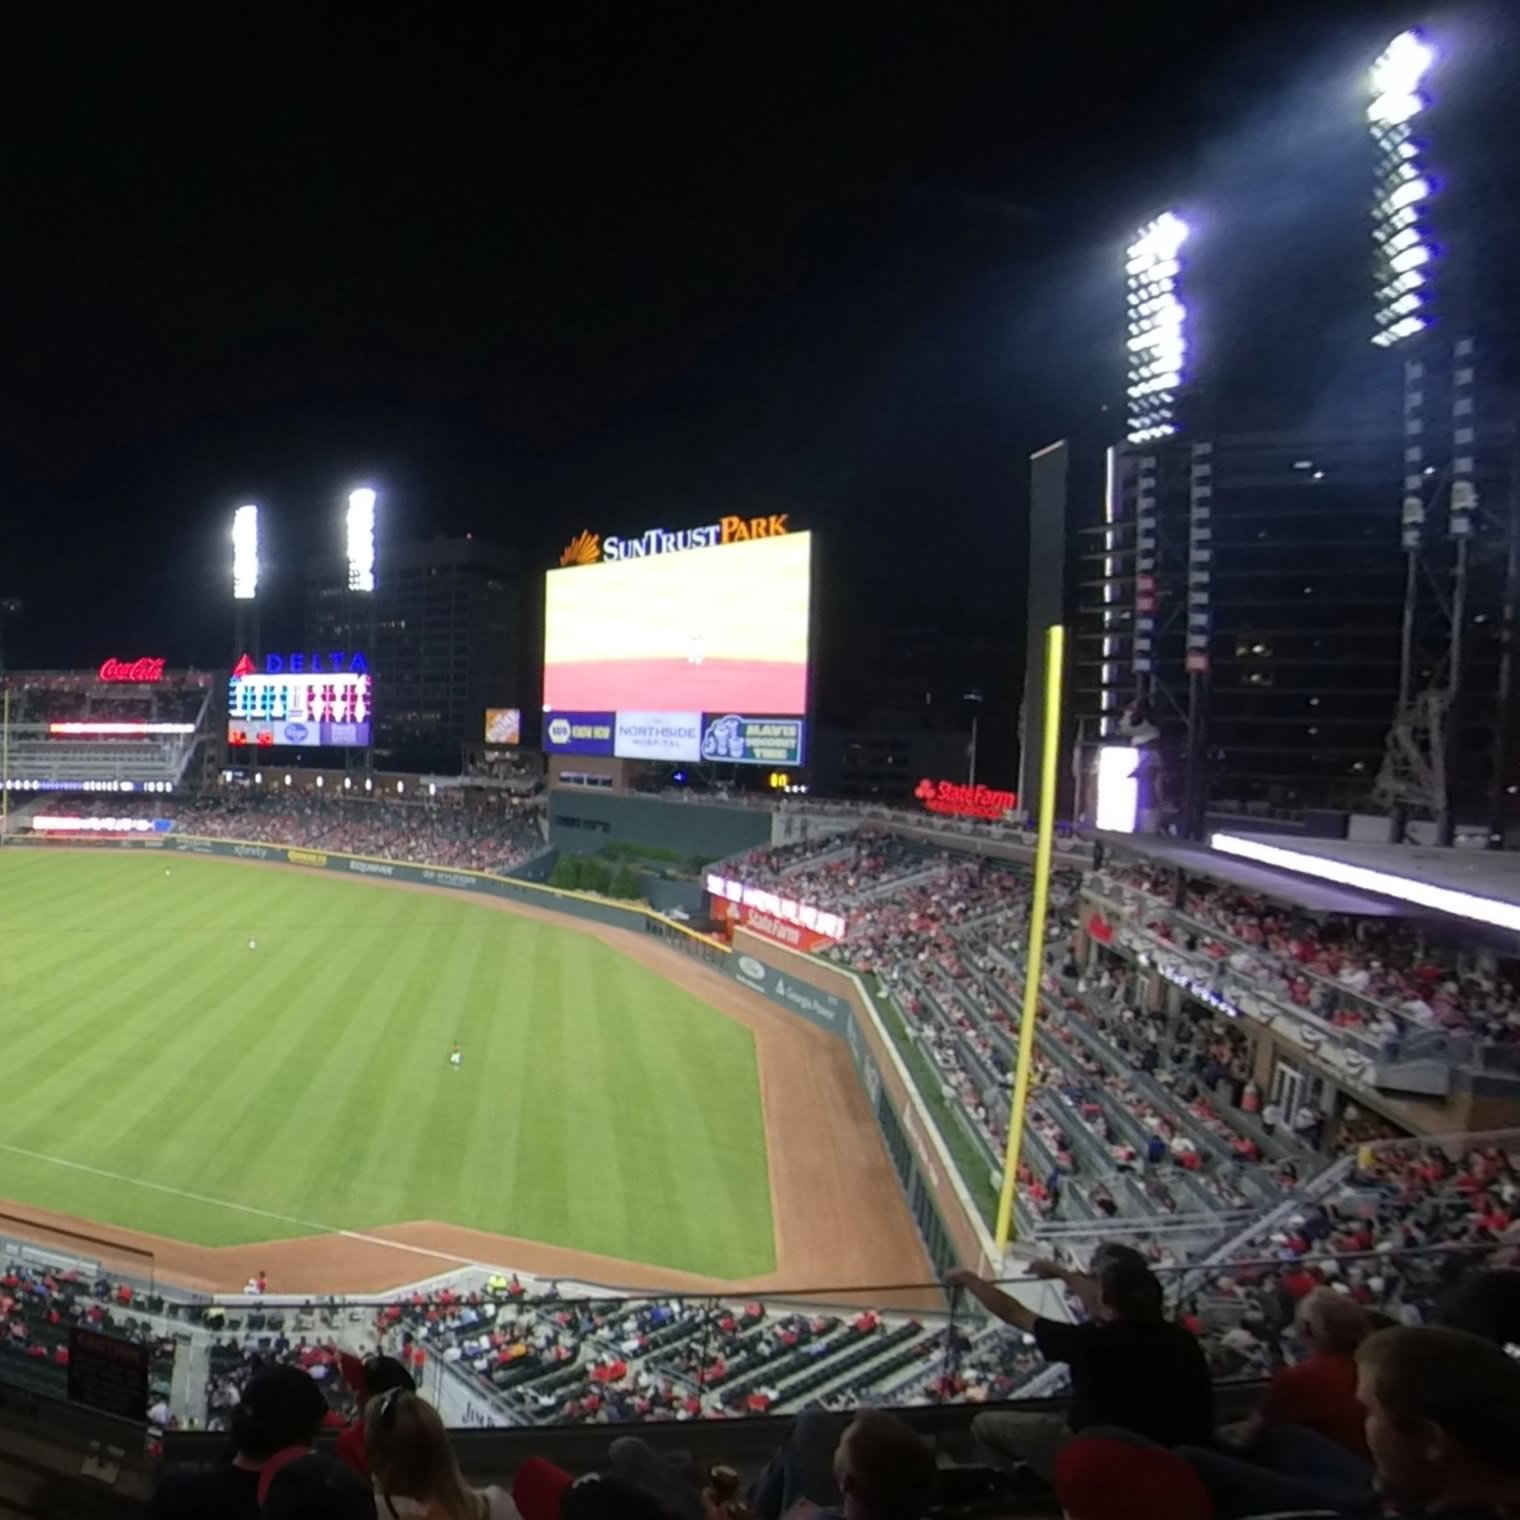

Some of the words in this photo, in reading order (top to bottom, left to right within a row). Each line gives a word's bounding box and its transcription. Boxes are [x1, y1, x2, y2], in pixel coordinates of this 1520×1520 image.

[266, 650, 369, 673] DELTA
[619, 726, 697, 739] NORTHSIDE
[233, 845, 268, 859] xfinity
